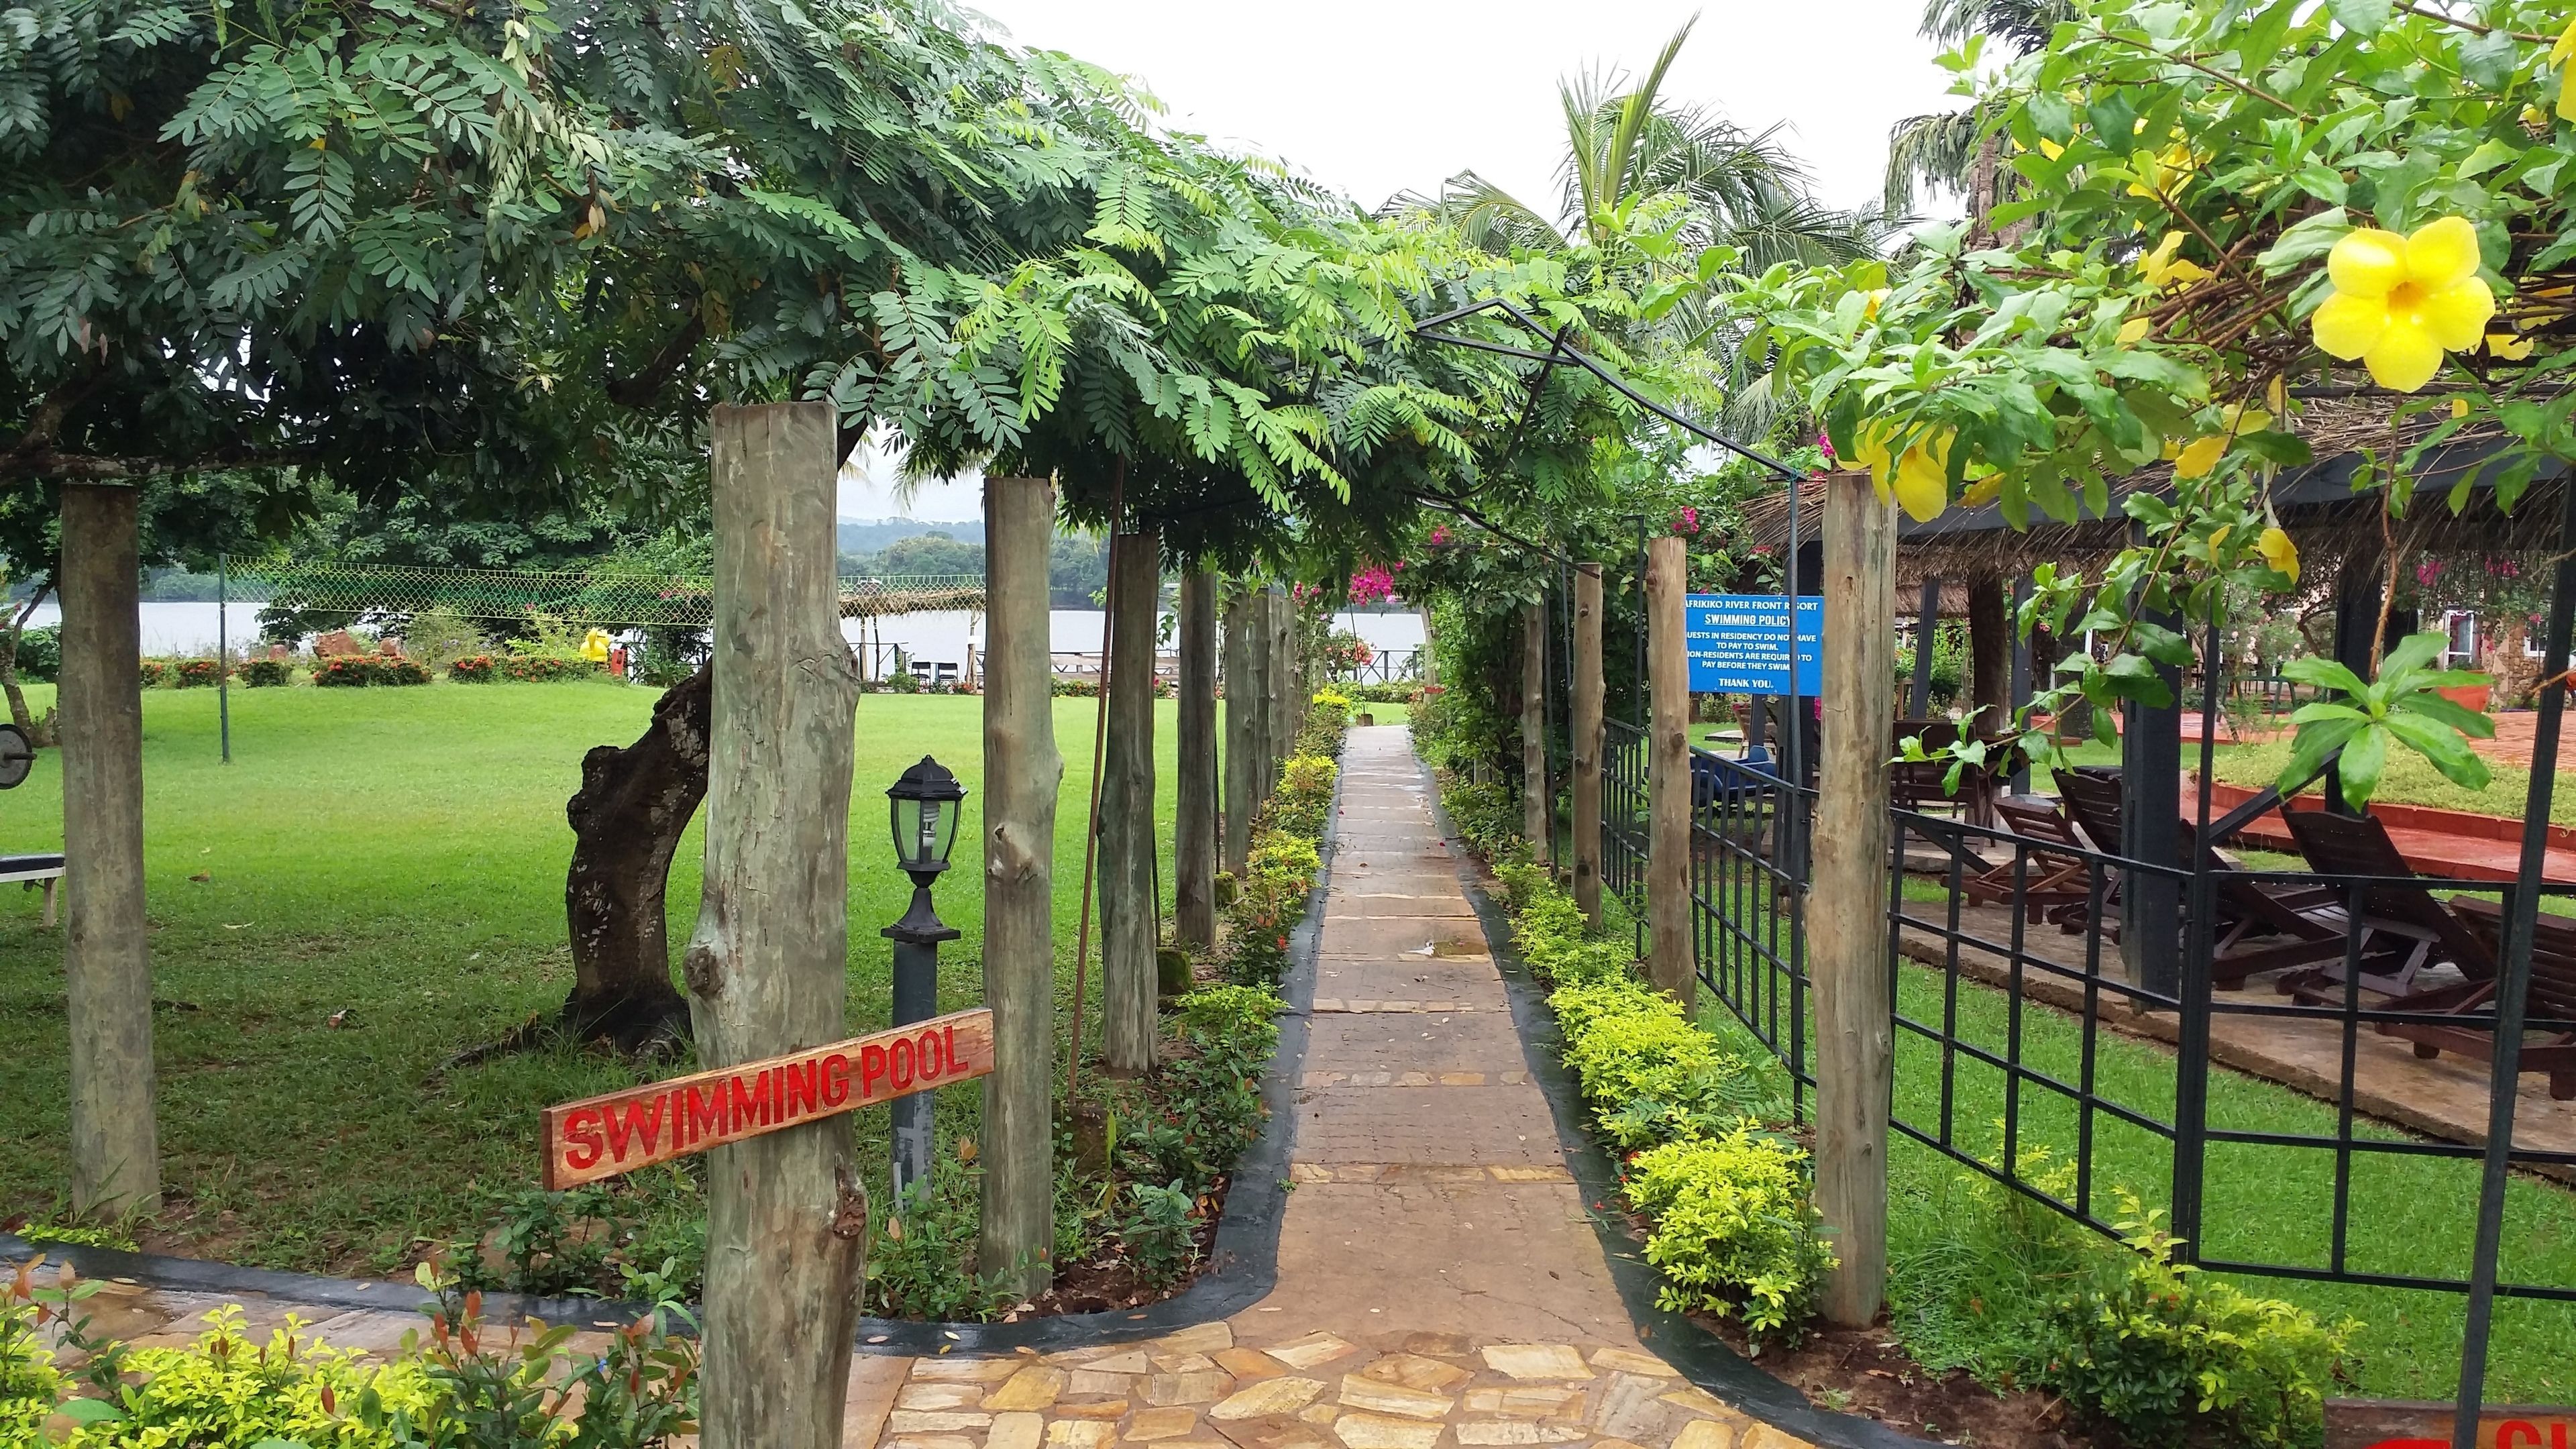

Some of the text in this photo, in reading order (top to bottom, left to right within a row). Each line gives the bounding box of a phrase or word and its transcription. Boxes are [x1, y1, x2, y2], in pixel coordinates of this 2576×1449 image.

[1725, 600, 1750, 609] RIVER
[1752, 601, 1782, 610] FRONT
[1784, 602, 1818, 611] RORT
[1705, 614, 1756, 625] SWIMMING
[1686, 631, 1710, 639] UESTS
[1755, 643, 1779, 651] SWIM.
[1761, 653, 1800, 661] REQUIR
[1718, 678, 1774, 688] THANK YOU.
[563, 1025, 969, 1170] SWIMMING POOL
